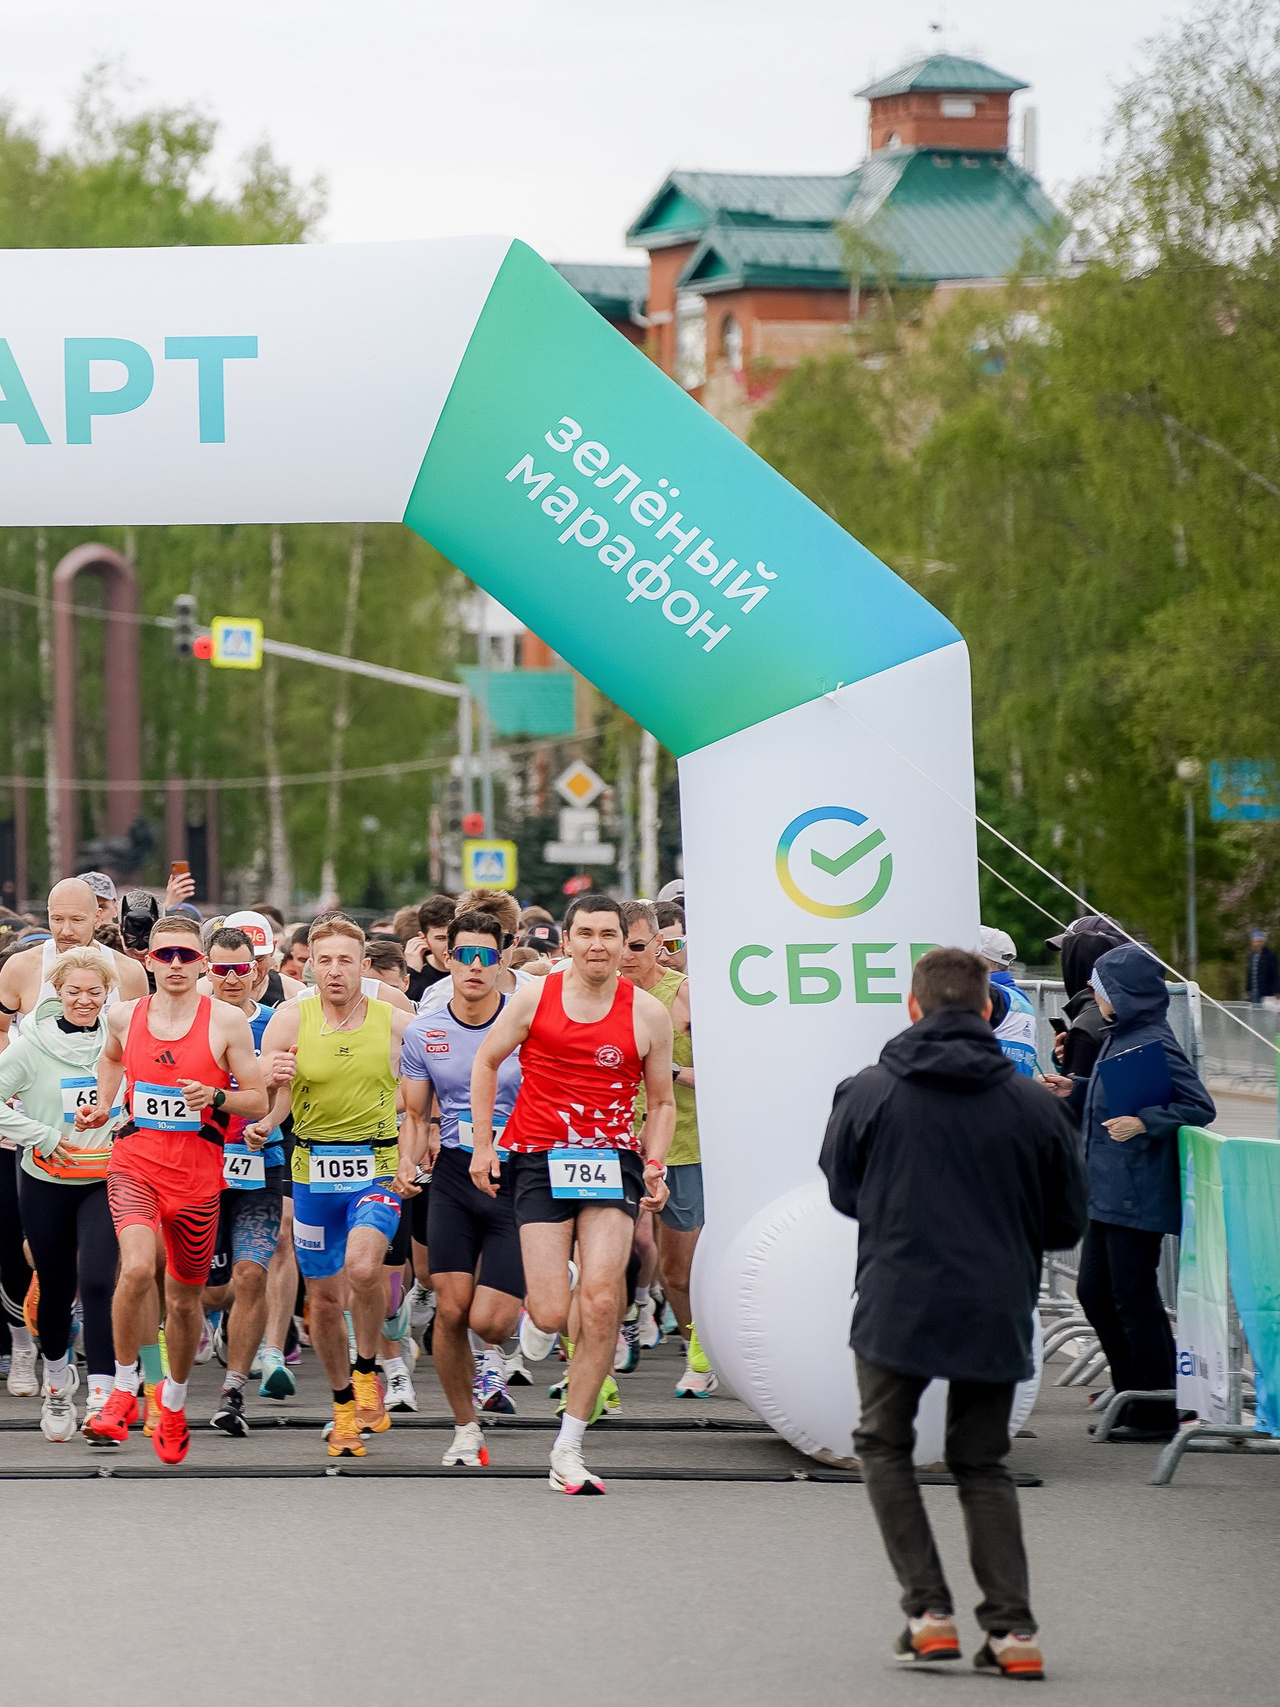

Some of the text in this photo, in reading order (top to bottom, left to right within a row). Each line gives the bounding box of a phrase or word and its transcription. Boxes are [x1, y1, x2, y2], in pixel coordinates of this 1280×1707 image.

[544, 415, 778, 615] зелёный
[504, 452, 732, 653] марафон
[729, 942, 944, 1006] СБЕ
[76, 1090, 98, 1108] 68
[146, 1098, 186, 1118] 812
[316, 1159, 369, 1178] 1055
[564, 1163, 607, 1183] 784
